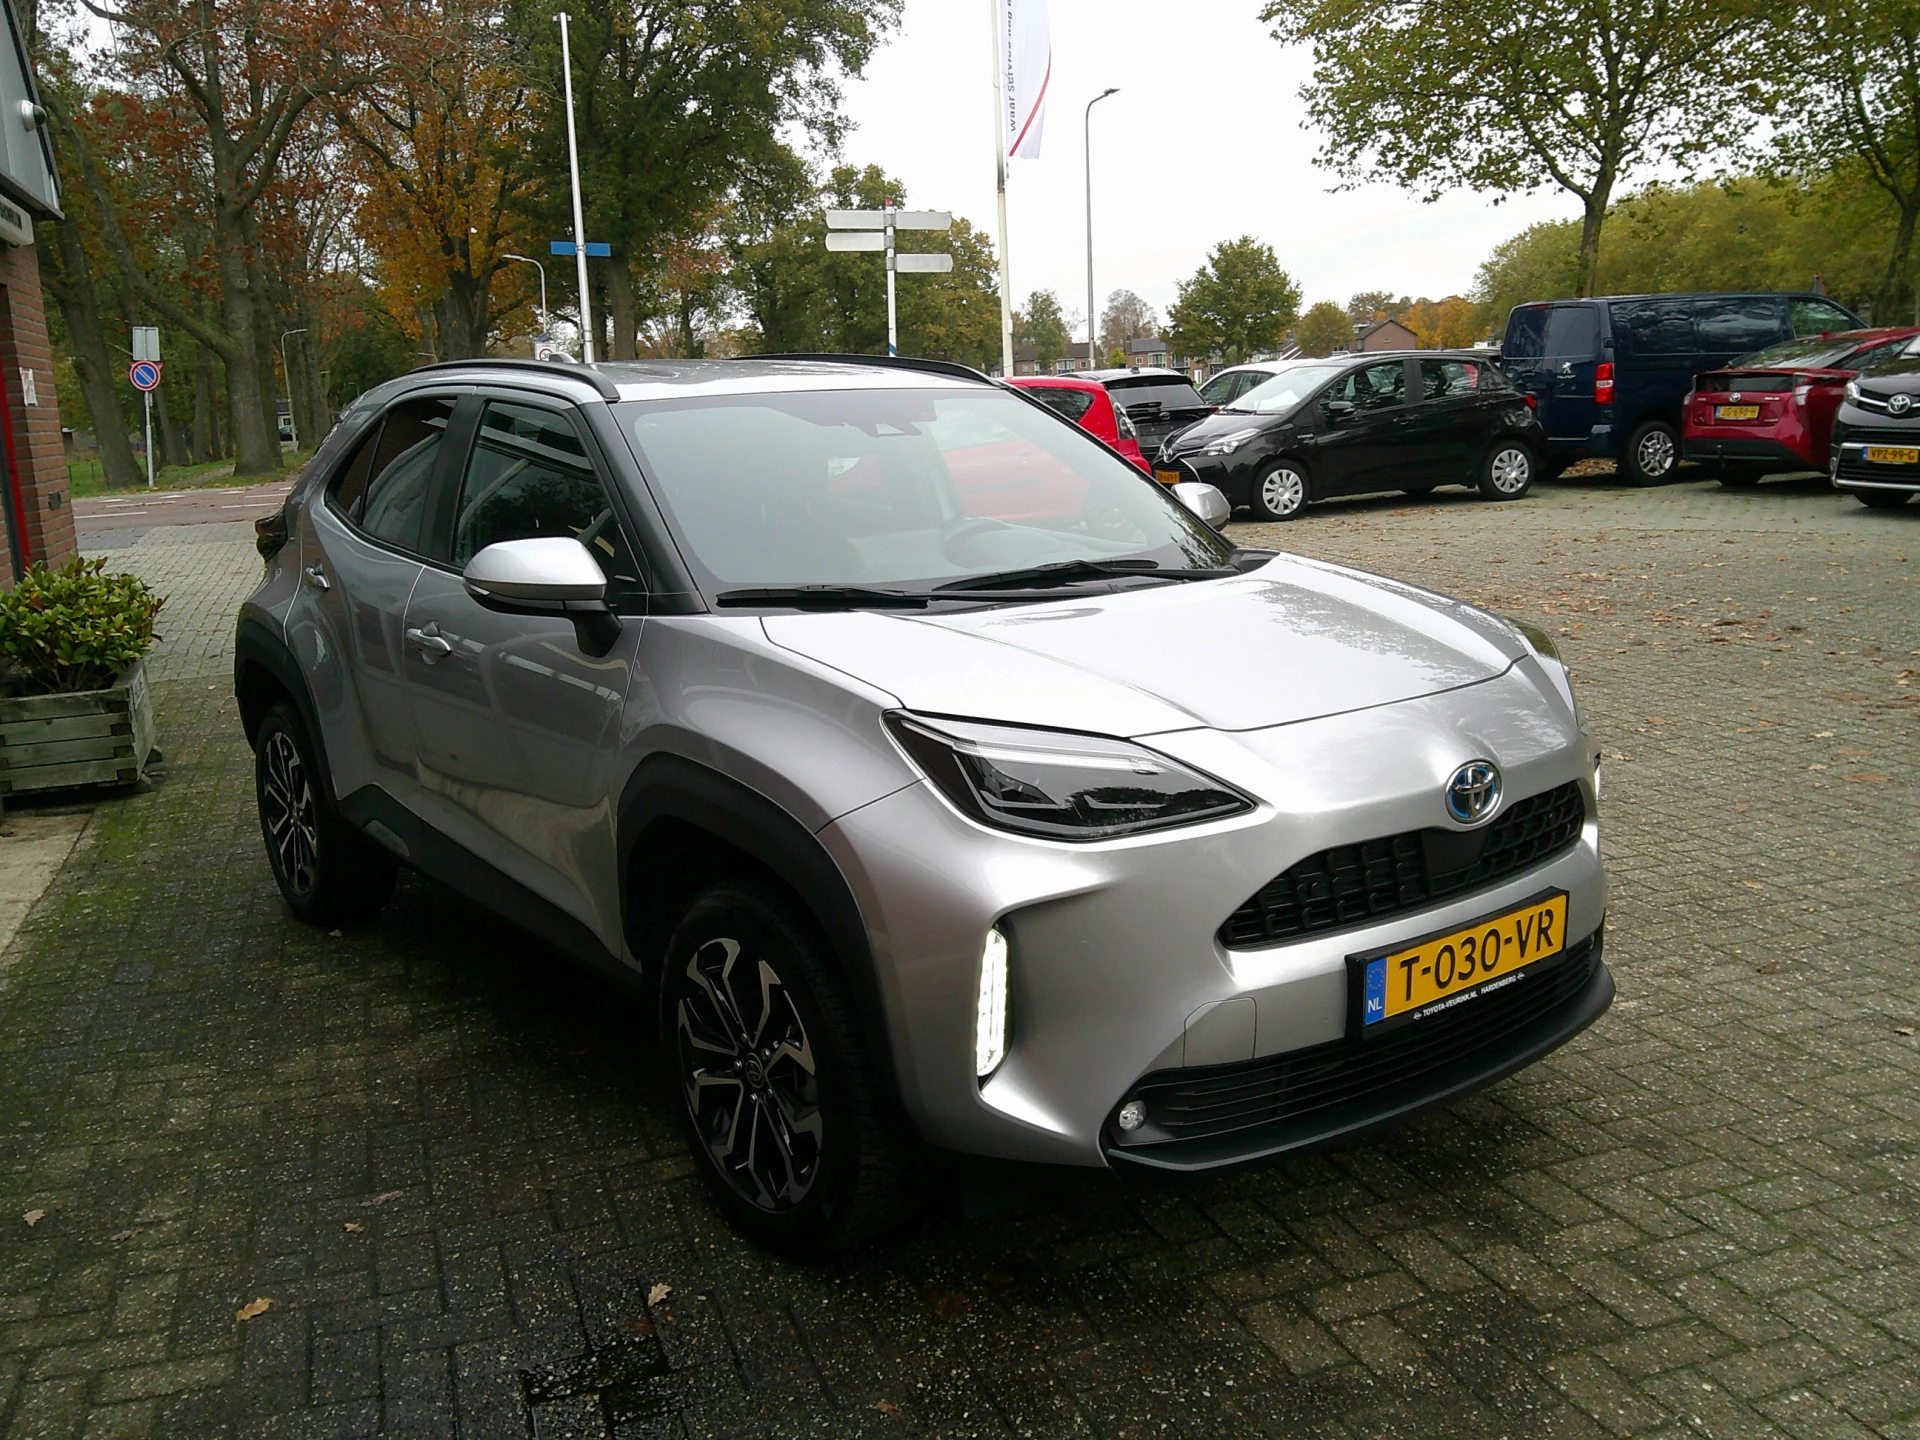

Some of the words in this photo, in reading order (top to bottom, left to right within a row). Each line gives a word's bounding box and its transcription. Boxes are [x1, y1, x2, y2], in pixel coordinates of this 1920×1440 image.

[1008, 96, 1016, 132] waar
[1871, 449, 1915, 460] VPZ-99-G
[1400, 908, 1554, 1002] T-030-VR
[1367, 998, 1383, 1013] NL
[1422, 990, 1478, 1017] TOYOTA-VEURINK.NL
[1481, 974, 1517, 995] HARDENBERG
